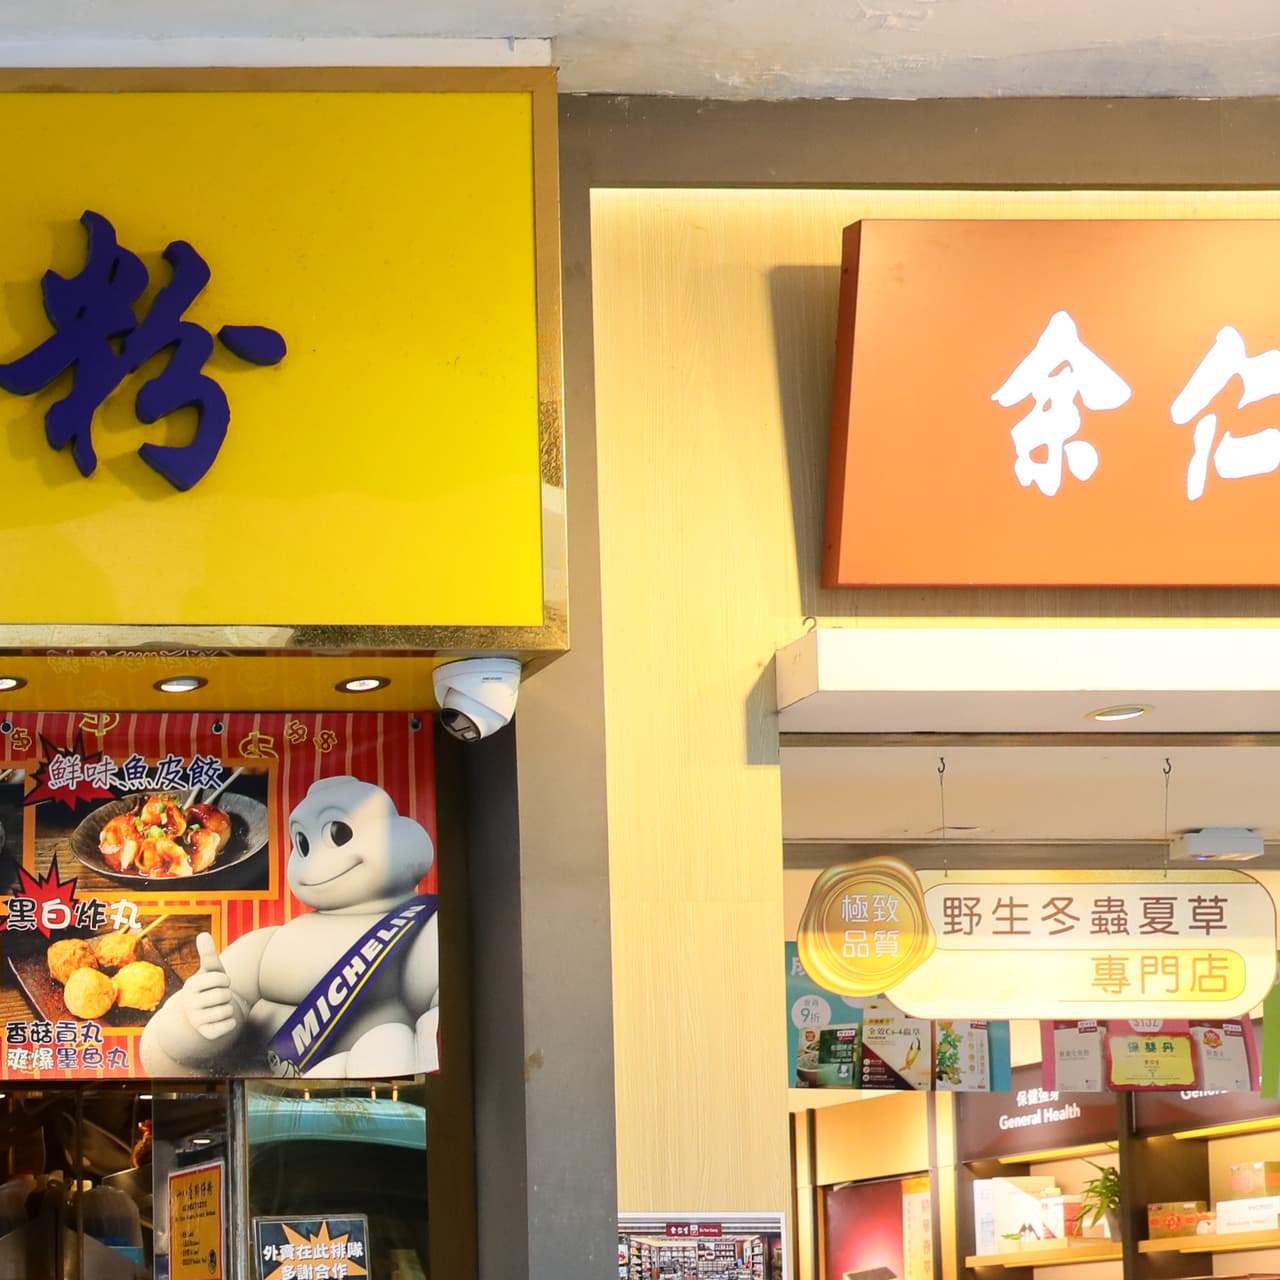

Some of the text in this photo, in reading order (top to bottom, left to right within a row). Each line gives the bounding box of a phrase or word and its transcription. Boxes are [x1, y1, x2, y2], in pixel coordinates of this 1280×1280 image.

[990, 310, 1280, 501] 余仁
[47, 754, 227, 792] 鮮味魚皮餃
[7, 896, 142, 933] 黑白炸丸
[841, 894, 900, 923] 極致
[942, 895, 1230, 938] 野生冬蟲夏草
[842, 930, 901, 960] 品質
[291, 902, 428, 1059] MICHELIN
[1091, 954, 1230, 995] 專門店
[7, 1020, 104, 1045] 香菇貢丸
[7, 1047, 131, 1071] 爽爆墨魚丸
[999, 1103, 1082, 1131] General Health
[262, 1240, 364, 1263] 外賣在此排隊
